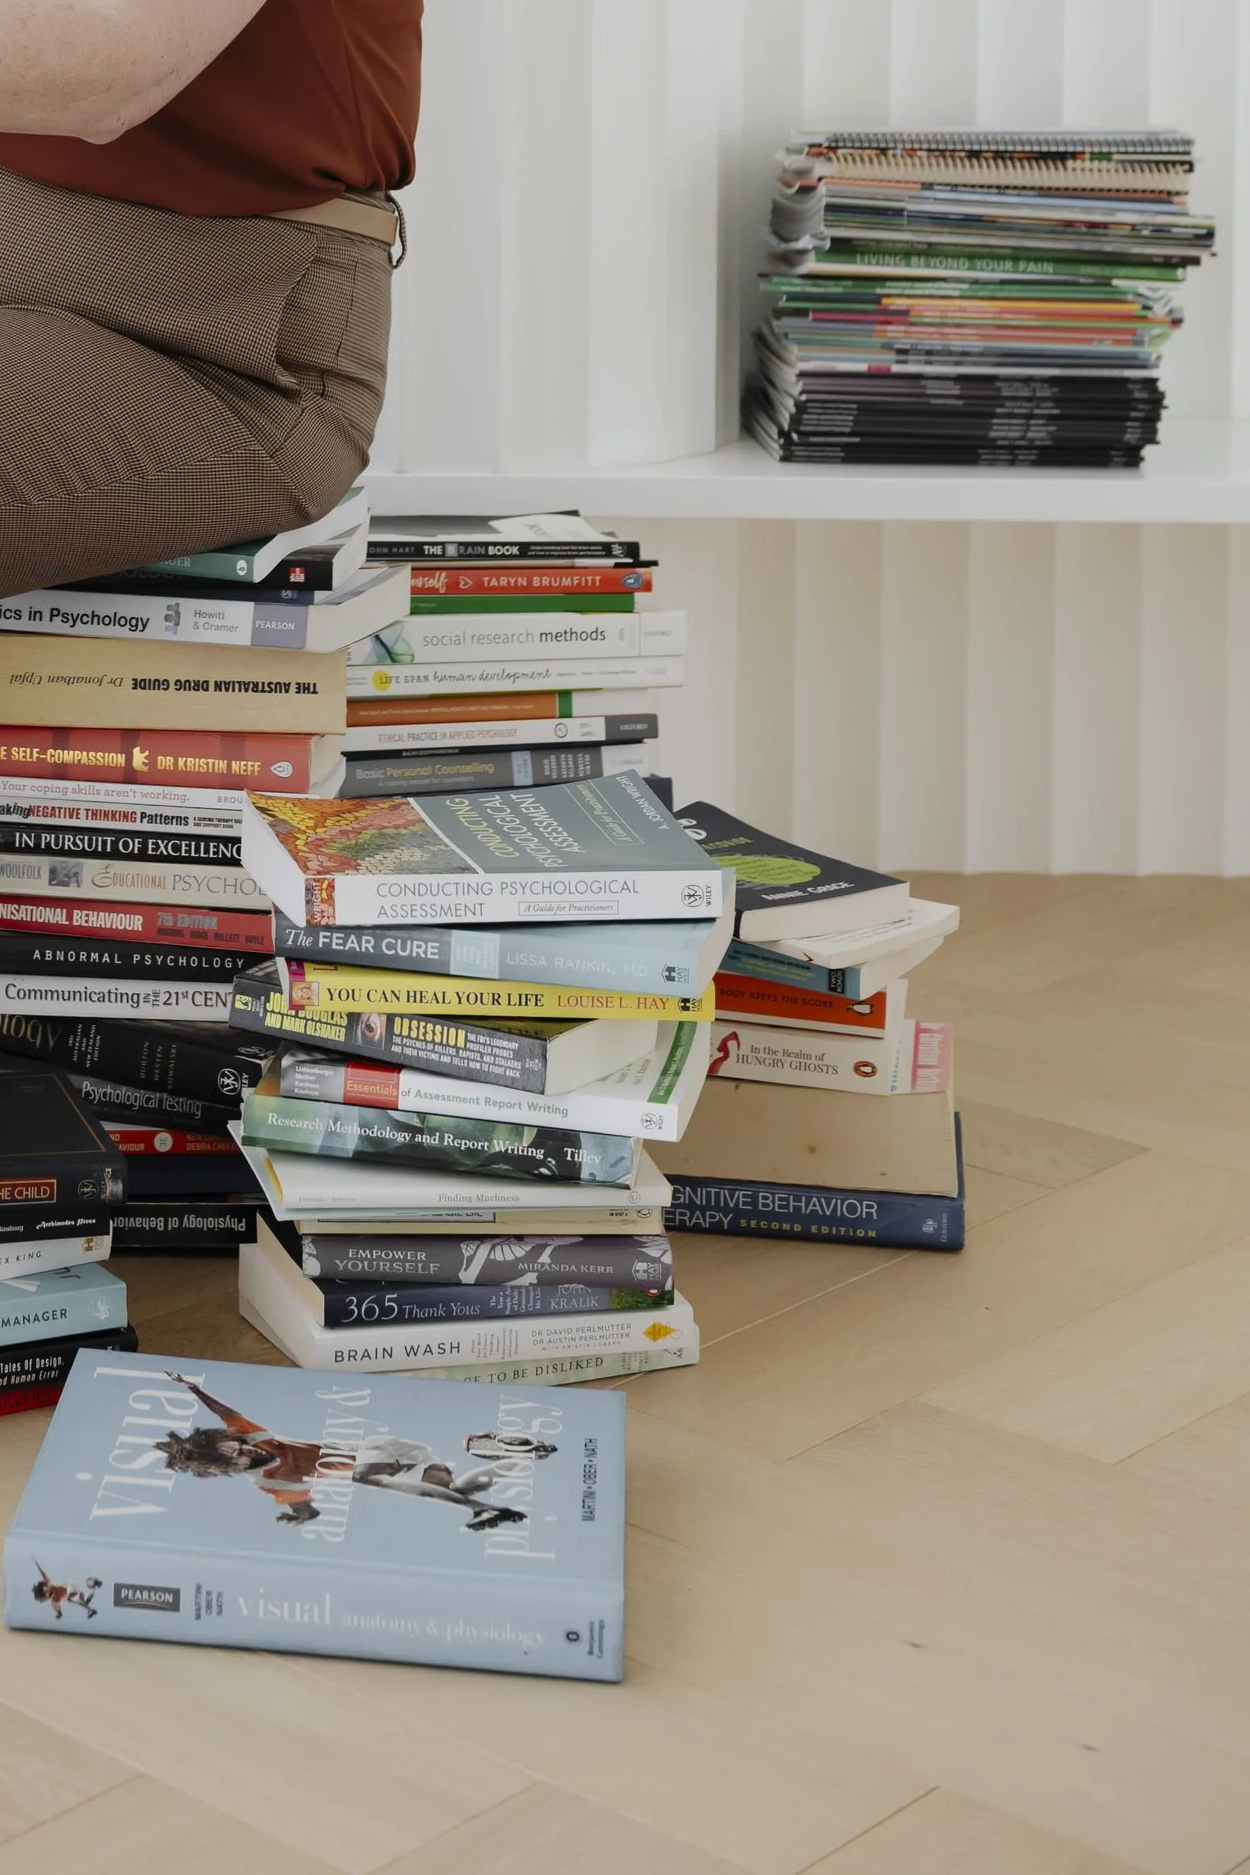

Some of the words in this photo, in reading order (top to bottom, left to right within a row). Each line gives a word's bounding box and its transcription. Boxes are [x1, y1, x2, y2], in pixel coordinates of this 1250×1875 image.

[855, 252, 905, 268] LIVING
[909, 254, 971, 270] BEYOND
[974, 256, 1015, 272] YOUR
[1018, 258, 1055, 275] PAIN
[482, 575, 528, 588] TARYN
[532, 575, 601, 588] BRUMFITT
[27, 605, 43, 622] in
[49, 607, 150, 633] Psychology
[194, 608, 225, 620] Howitt
[255, 619, 296, 631] PEARSON
[422, 630, 466, 647] social
[470, 628, 535, 645] research
[538, 626, 607, 644] methods
[11, 747, 126, 768] SELF-COMPASSION
[156, 756, 176, 770] DR
[177, 757, 229, 774] KRISTIN
[231, 760, 262, 776] NEFF
[15, 831, 36, 849] IN
[41, 833, 112, 854] PURSUIT
[118, 837, 143, 855] OF
[376, 881, 494, 899] CONDUCTING
[500, 879, 639, 896] PSYCHOLOGICAL
[72, 909, 144, 933] BEHAVIOUR
[376, 902, 485, 920] ASSESSMENT
[283, 926, 314, 951] The
[318, 931, 382, 954] FEAR
[384, 937, 441, 960] CURE
[32, 948, 123, 966] ABNORMAL
[132, 953, 245, 970] PSYCHOLOGY
[326, 987, 362, 1003] YOU
[366, 988, 402, 1004] CAN
[405, 990, 454, 1006] HEAL
[454, 991, 512, 1007] YOUR
[513, 993, 545, 1008] LIFE
[557, 994, 613, 1010] LOUISE
[617, 996, 634, 1010] L.
[636, 996, 670, 1012] HAY
[719, 988, 747, 999] BODY
[749, 990, 779, 1003] KEEPS
[781, 993, 800, 1004] THE
[802, 995, 835, 1009] SCORE
[393, 1016, 467, 1049] OBSESSION
[749, 1044, 761, 1055] In
[763, 1045, 780, 1057] the
[782, 1047, 812, 1061] Realm
[814, 1051, 827, 1063] of
[734, 1053, 789, 1070] HUNGRY
[791, 1058, 839, 1076] GHOSTS
[82, 1081, 160, 1111] Psychological
[162, 1091, 203, 1120] Testing
[346, 1081, 398, 1097] Essentials
[401, 1087, 412, 1098] of
[414, 1088, 482, 1107] Assessment
[484, 1096, 523, 1113] Report
[526, 1100, 569, 1119] Writing
[267, 1111, 324, 1131] Research
[327, 1119, 413, 1144] Methodology
[415, 1129, 440, 1146] and
[443, 1133, 491, 1153] Report
[493, 1138, 545, 1161] Writing
[563, 1146, 603, 1167] Tilley
[14, 1185, 51, 1200] CHILD
[438, 1192, 473, 1205] Finding
[475, 1192, 520, 1204] Muchness
[758, 1190, 878, 1221] BEHAVIOR
[740, 1218, 803, 1233] SECOND
[810, 1224, 878, 1239] EDITION
[348, 1248, 427, 1262] EMPOWER
[334, 1258, 441, 1275] YOURSELF
[517, 1261, 578, 1274] MIRANDA
[579, 1262, 615, 1275] KERR
[340, 1292, 400, 1324] 365
[402, 1301, 449, 1320] Thank
[450, 1300, 481, 1318] Yous
[550, 1295, 600, 1311] KRALIK
[0, 1307, 69, 1330] MANAGER
[531, 1329, 544, 1338] DR
[546, 1327, 573, 1337] DAVID
[574, 1323, 633, 1335] PERLMUTTER
[532, 1338, 545, 1346] DR
[547, 1336, 577, 1346] AUSTIN
[579, 1331, 632, 1343] PERLMUTTER
[334, 1346, 400, 1364] BRAIN
[403, 1340, 462, 1358] WASH
[0, 1362, 22, 1375] Tales
[24, 1358, 34, 1372] Of
[121, 1588, 174, 1604] PEARSON
